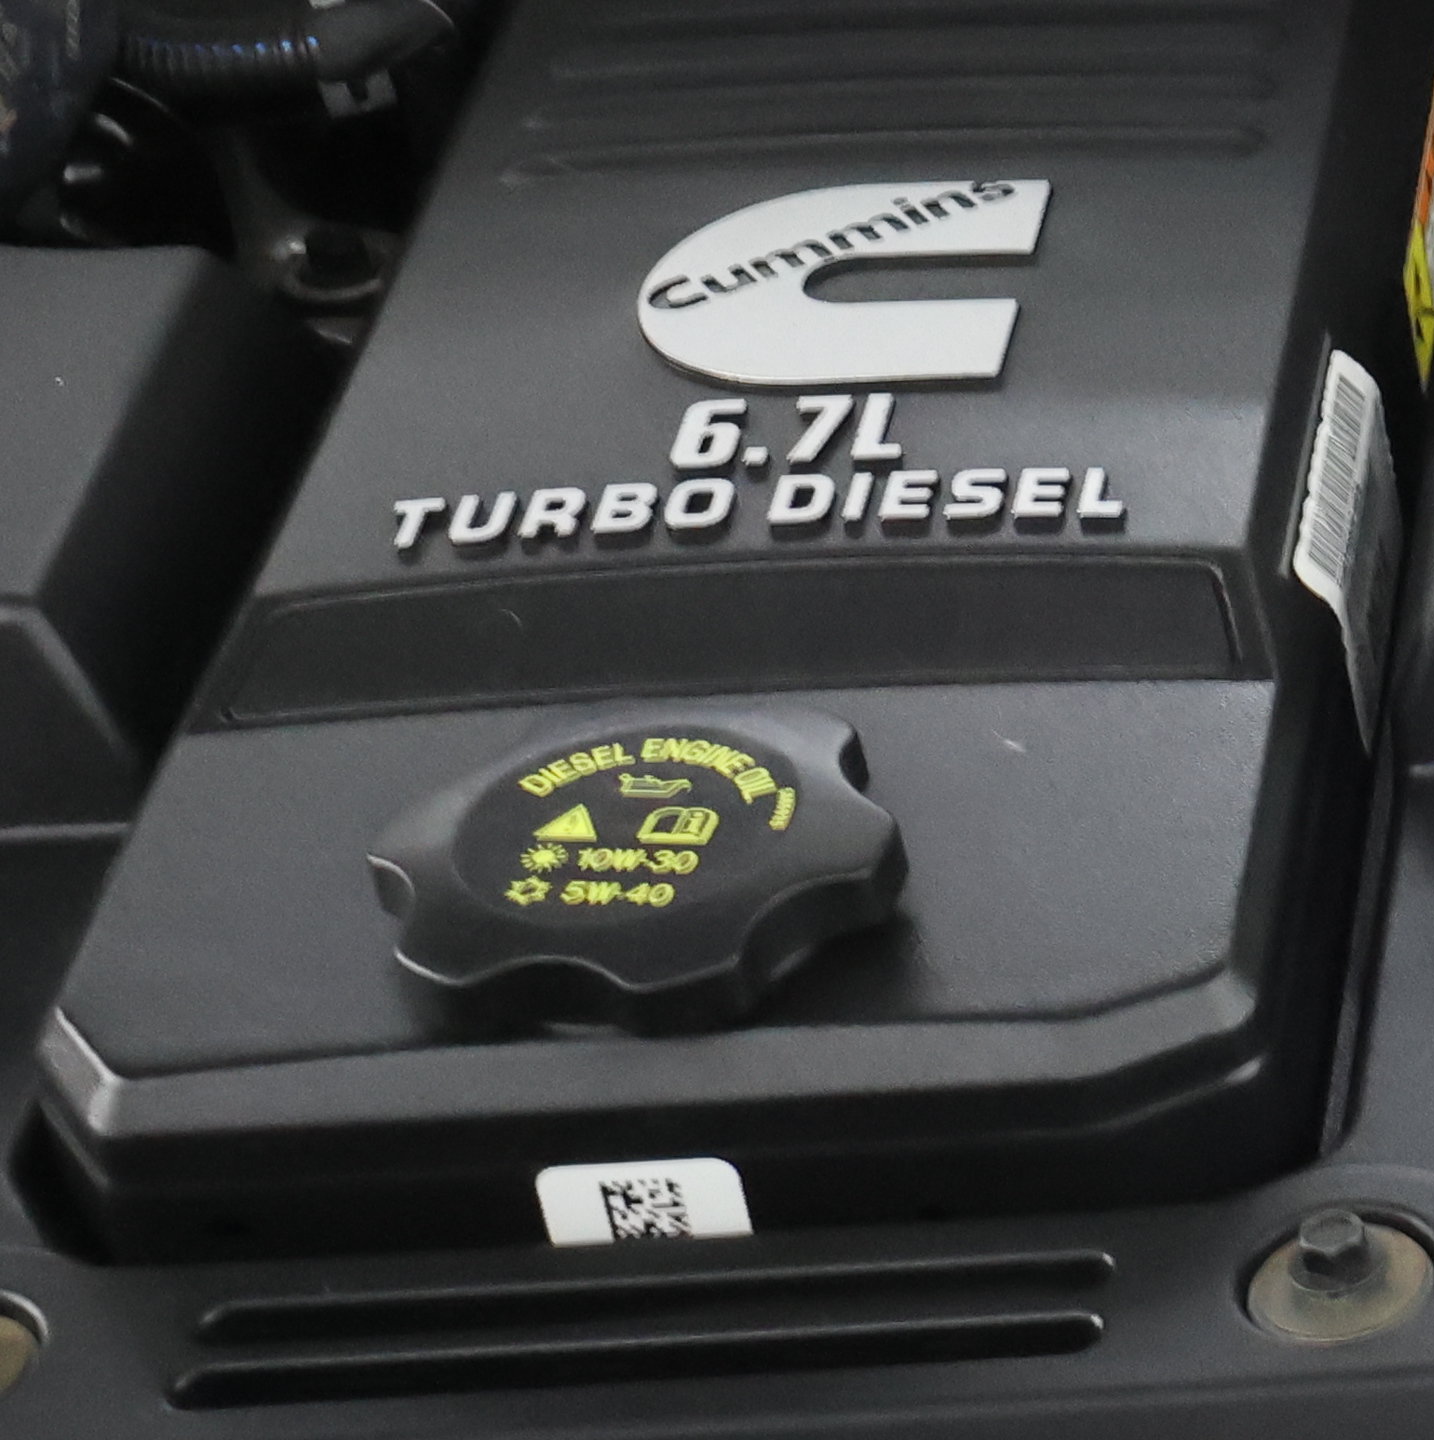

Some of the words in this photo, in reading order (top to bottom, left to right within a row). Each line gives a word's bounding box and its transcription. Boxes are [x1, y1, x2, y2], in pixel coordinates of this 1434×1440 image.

[648, 179, 1016, 310] Cummins
[669, 392, 903, 470] 6.7L
[394, 476, 735, 549] TURBO
[766, 466, 1126, 527] DIESEL
[518, 742, 636, 798] DIESEL
[640, 737, 756, 781] ENGINE
[734, 766, 778, 805] OIL
[560, 880, 676, 908] 5W-40
[577, 847, 700, 875] 10W-30
